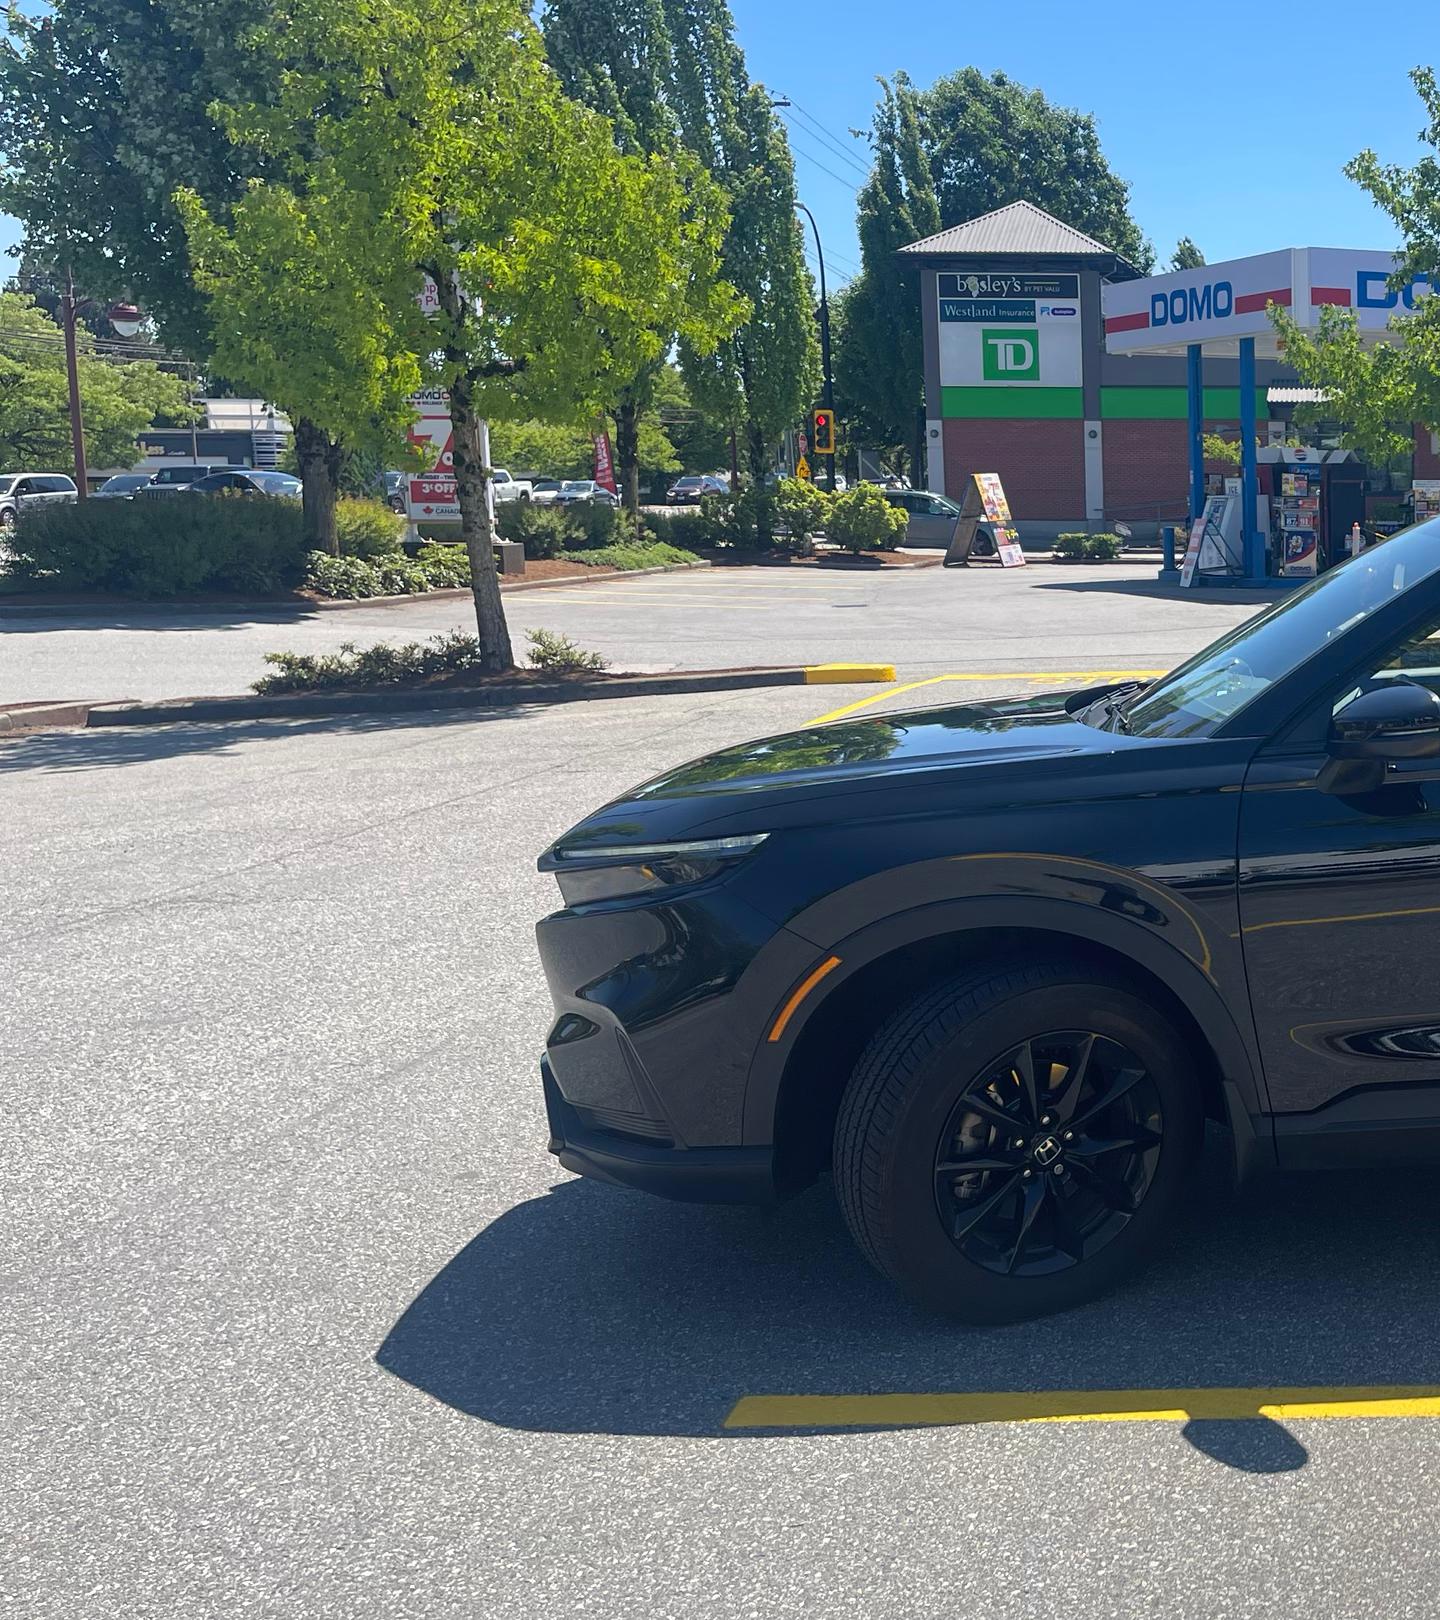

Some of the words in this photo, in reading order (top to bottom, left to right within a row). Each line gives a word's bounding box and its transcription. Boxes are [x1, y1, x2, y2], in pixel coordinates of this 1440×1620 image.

[944, 304, 996, 317] Westland
[998, 308, 1035, 316] Insurance
[1151, 281, 1233, 327] DOMO
[987, 338, 1034, 371] TD
